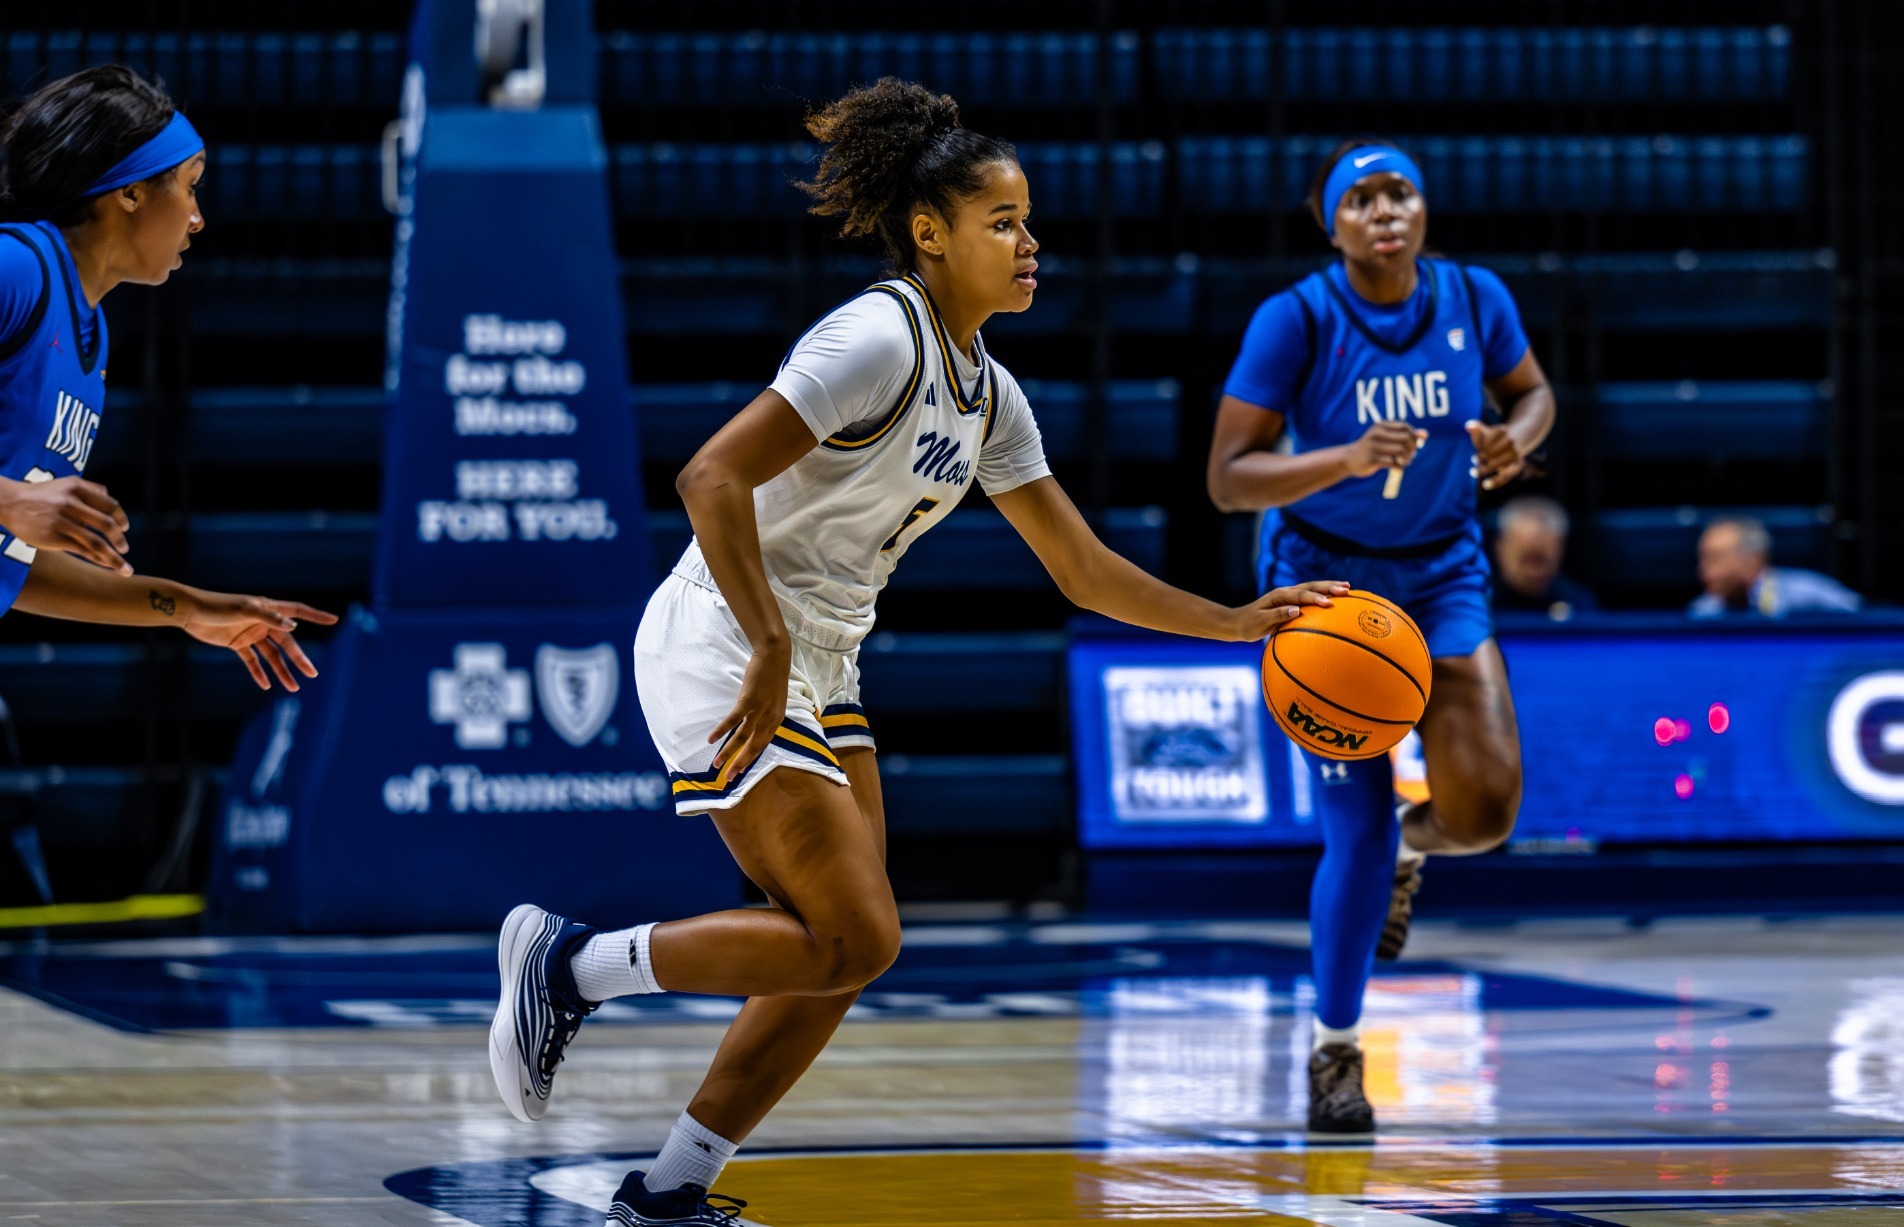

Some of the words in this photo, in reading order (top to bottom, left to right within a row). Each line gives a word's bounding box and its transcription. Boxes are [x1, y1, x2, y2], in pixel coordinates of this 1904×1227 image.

[465, 314, 566, 354] Here
[446, 354, 508, 395] for
[513, 355, 586, 395] the
[1356, 370, 1450, 424] KING
[45, 390, 100, 472] KING
[456, 460, 579, 499] HERE
[417, 501, 510, 541] FOR
[1287, 701, 1368, 750] NCAA
[384, 764, 439, 814] of
[440, 763, 669, 813] Tennessee
